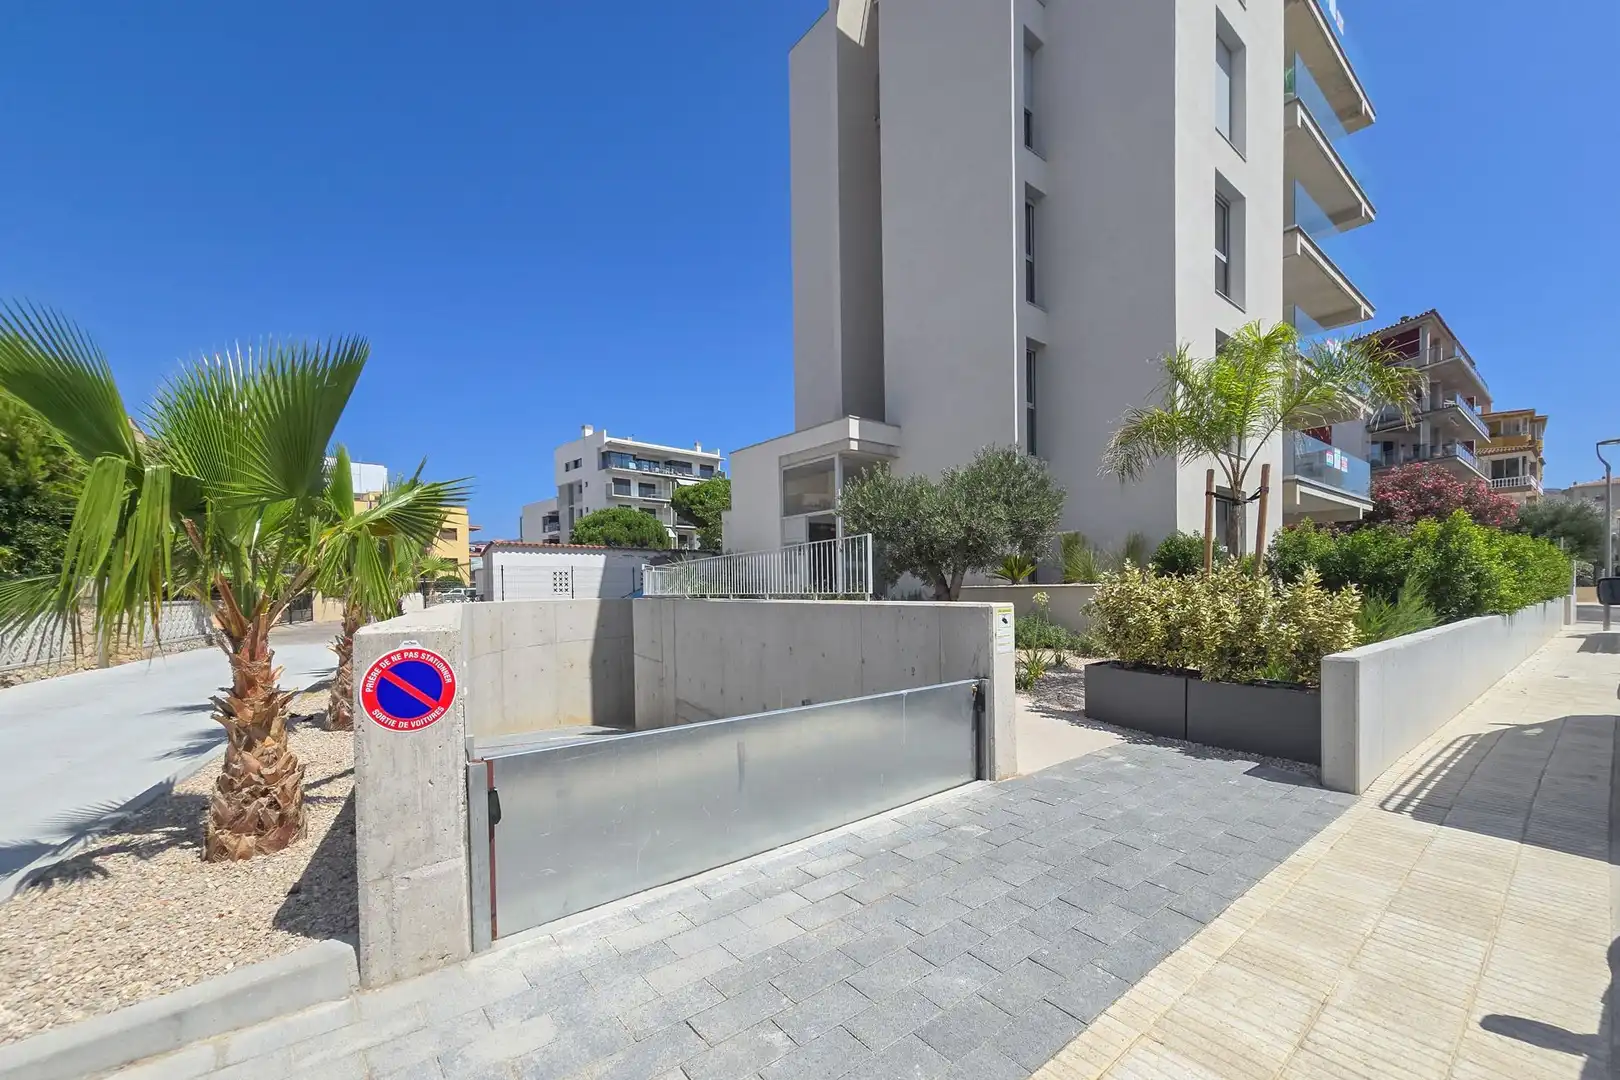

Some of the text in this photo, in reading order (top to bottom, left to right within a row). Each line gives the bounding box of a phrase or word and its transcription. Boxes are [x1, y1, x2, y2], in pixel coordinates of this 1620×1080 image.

[365, 651, 452, 693] PRIÈRE DE NE PAS STATIONNER
[372, 706, 445, 729] SORTIE DE VOITURES
